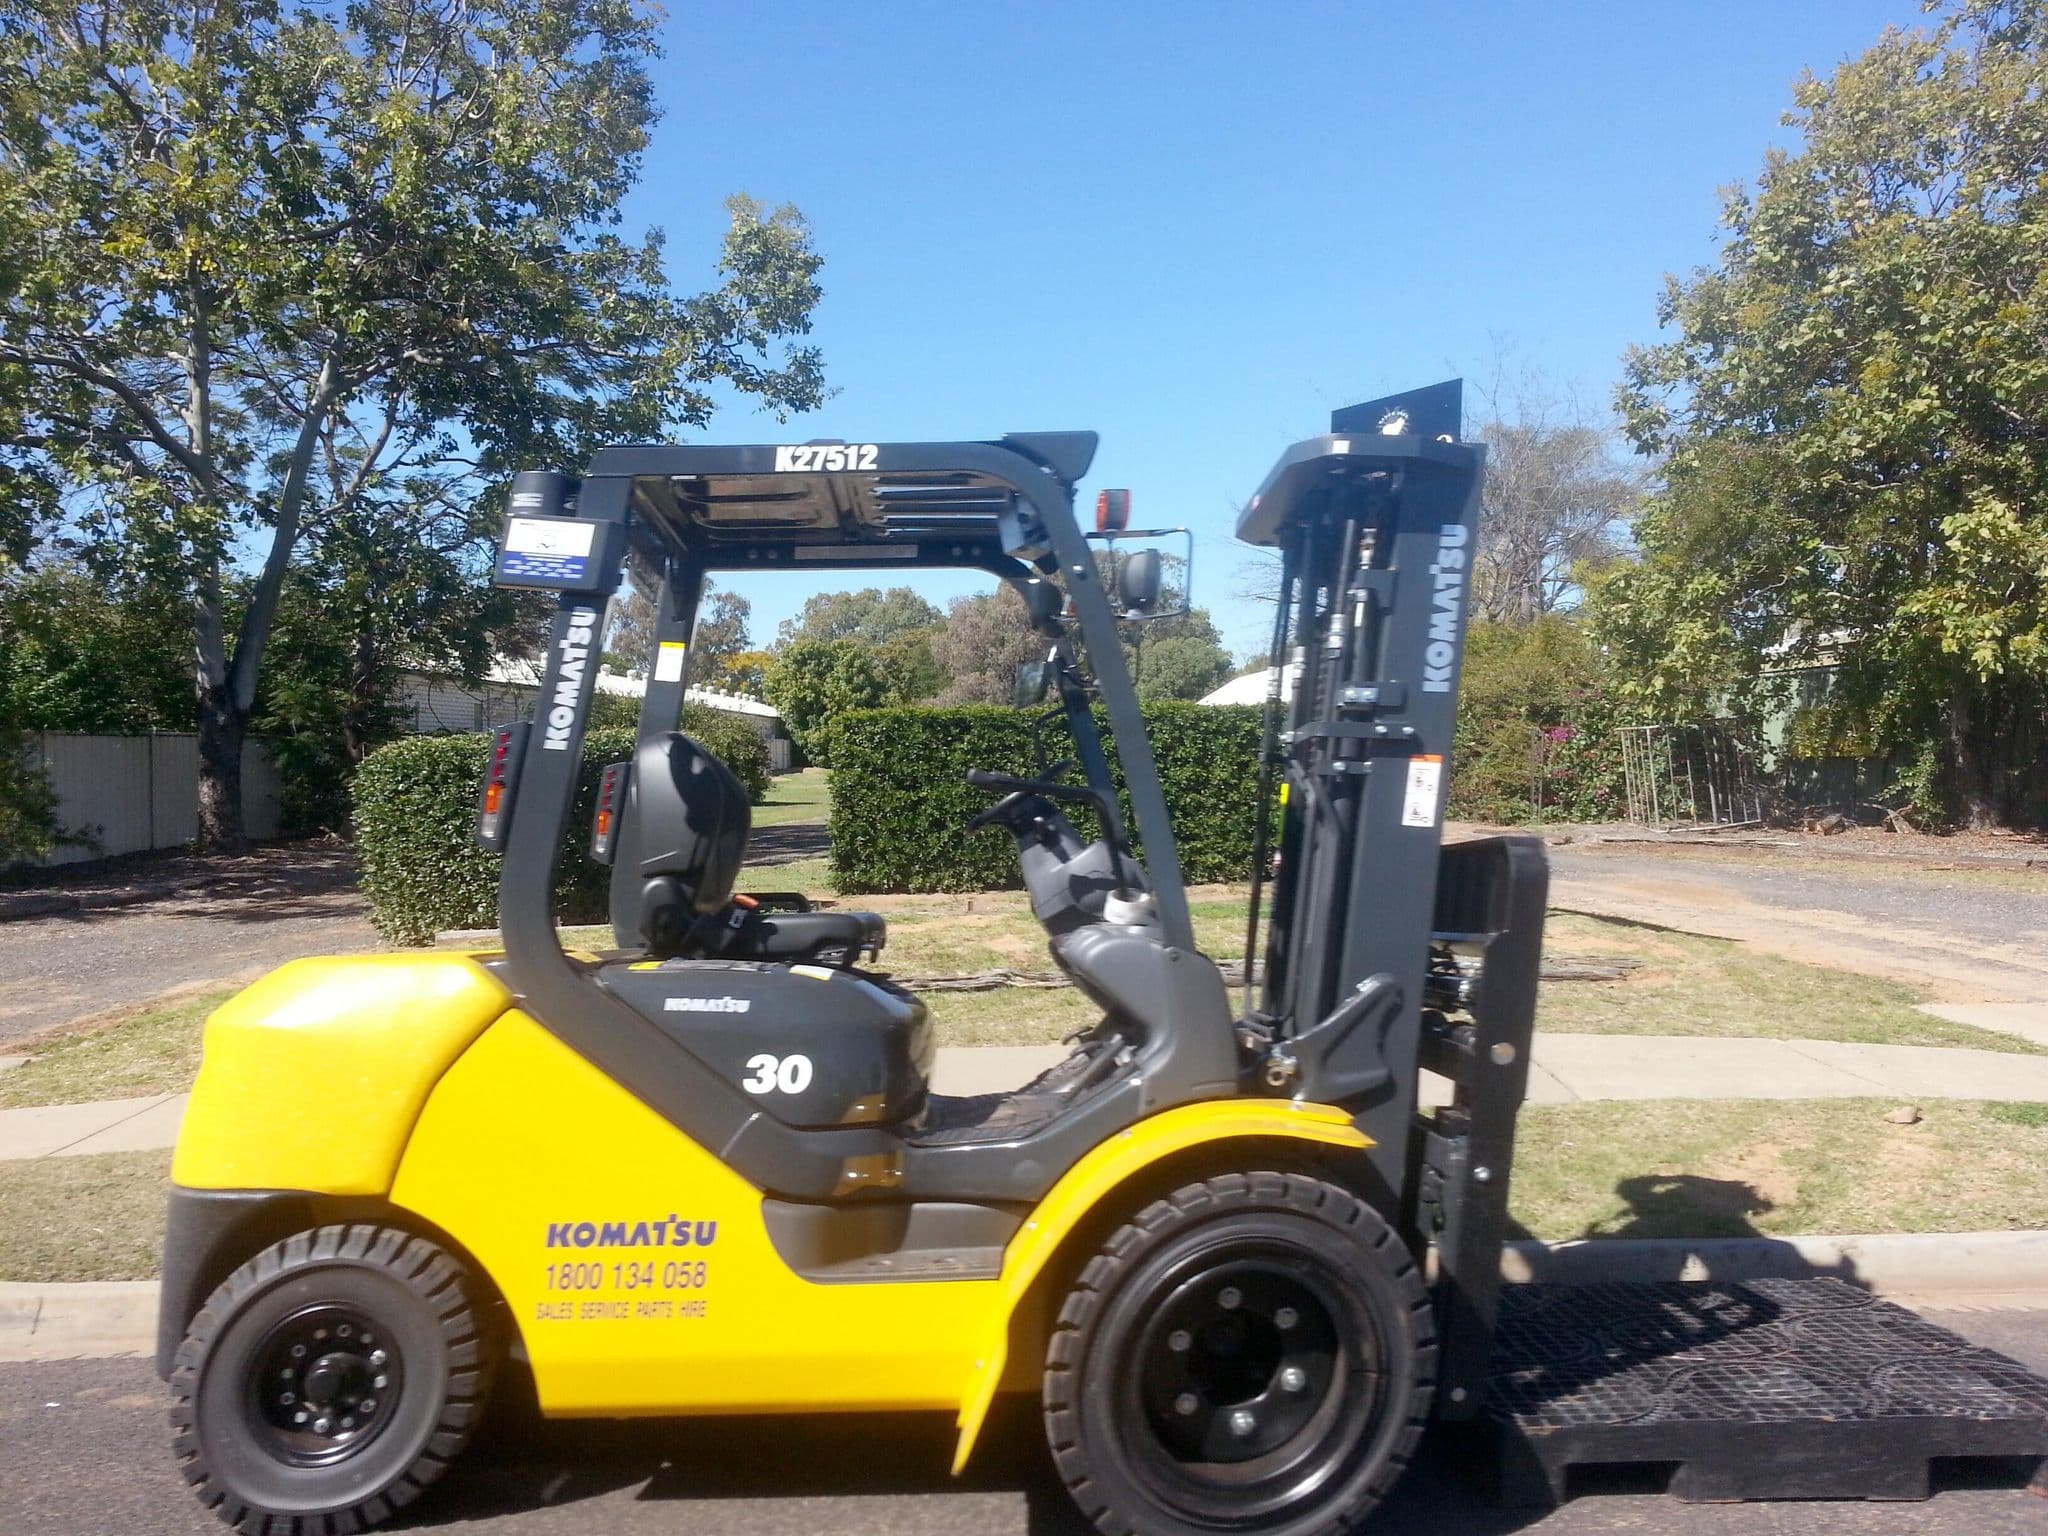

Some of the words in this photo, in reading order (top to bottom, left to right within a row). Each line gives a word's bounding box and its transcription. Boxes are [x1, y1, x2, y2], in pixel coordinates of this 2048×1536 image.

[775, 445, 879, 472] K27512
[1422, 524, 1469, 692] KOMATSU
[543, 606, 596, 750] KOMATSU
[664, 996, 751, 1013] KOMATSU
[743, 1054, 813, 1094] 30
[547, 1214, 716, 1248] KOMATSU
[547, 1263, 602, 1290] 1800
[614, 1262, 654, 1289] 134
[663, 1261, 706, 1289] 058
[537, 1302, 573, 1320] SALES
[581, 1301, 630, 1319] SERVICE
[637, 1301, 673, 1319] PARTS
[681, 1300, 707, 1318] HIRE
